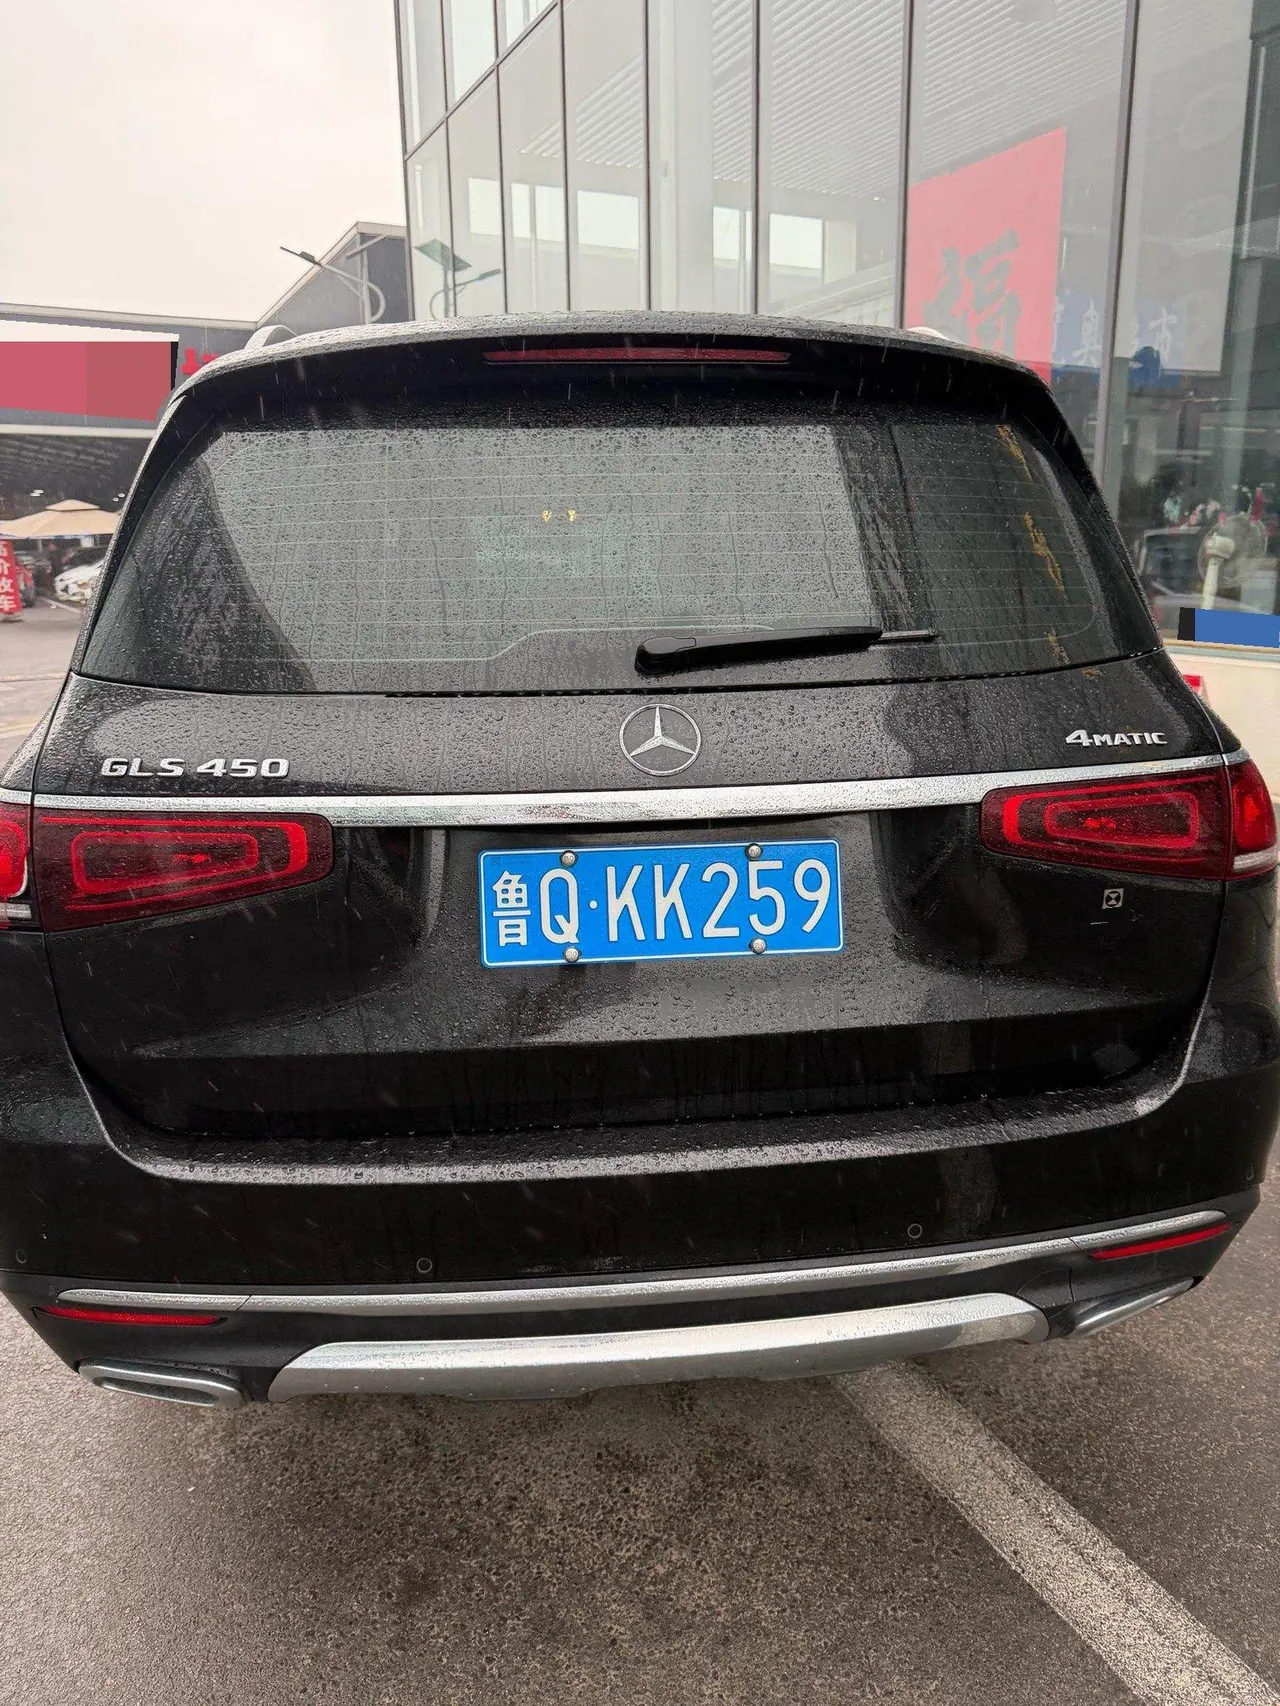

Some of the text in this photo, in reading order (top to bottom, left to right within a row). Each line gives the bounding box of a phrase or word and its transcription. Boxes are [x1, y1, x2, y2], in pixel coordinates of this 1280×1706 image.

[1065, 729, 1168, 747] 4MATIC
[101, 757, 290, 777] GLS 450
[492, 858, 832, 947] 鲁Q·KK259
